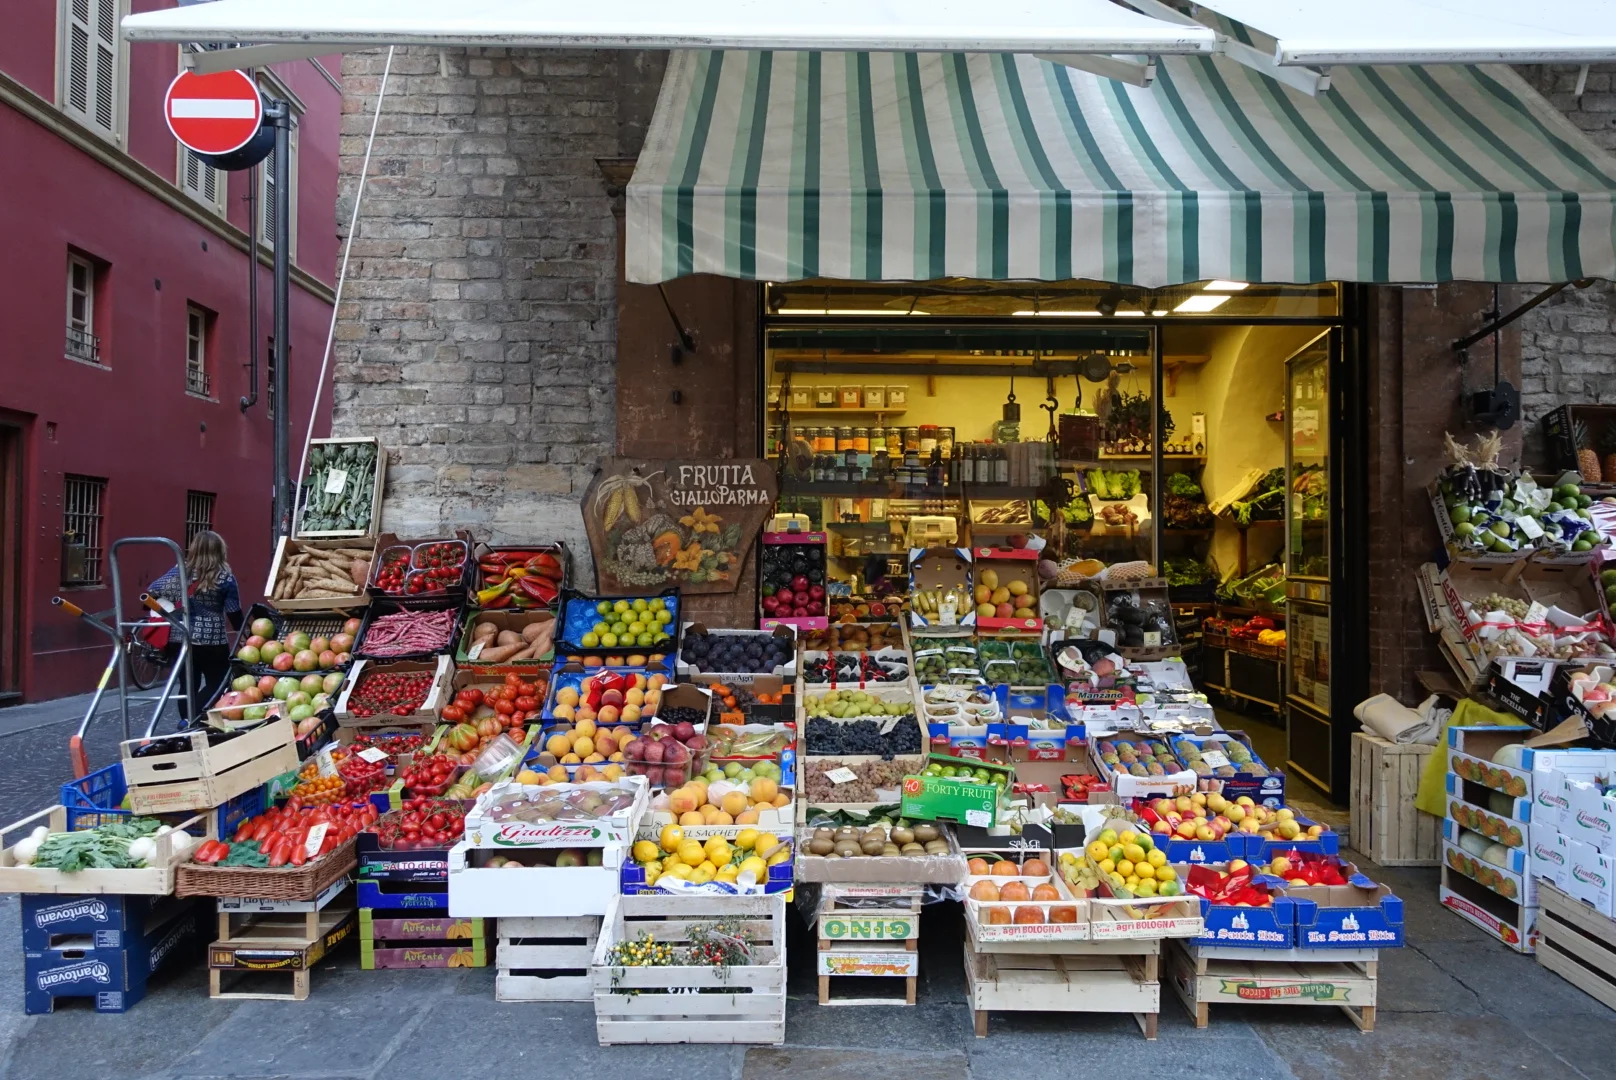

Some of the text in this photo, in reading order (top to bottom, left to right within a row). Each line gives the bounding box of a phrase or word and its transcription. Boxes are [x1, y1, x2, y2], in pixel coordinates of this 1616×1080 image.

[679, 465, 757, 489] FRUTTA
[670, 485, 770, 507] GIALLOPARMA
[1446, 588, 1474, 642] SELEXTA
[1500, 694, 1528, 717] EXCELLENT
[1509, 692, 1521, 704] THE
[904, 780, 919, 792] 40
[926, 783, 994, 800] FORTY FRUIT
[501, 824, 596, 840] Gradizzi
[382, 861, 416, 871] SALTO
[418, 861, 427, 870] di
[37, 901, 105, 926] Mantovani
[825, 920, 910, 939] GINO
[1002, 927, 1020, 936] agri
[1022, 926, 1062, 934] BOLOGNA
[1116, 920, 1176, 932] agri BOLOGNA
[1216, 928, 1255, 940] Santa
[1258, 929, 1284, 942] Rita
[1307, 929, 1395, 942] La Santa Rita
[39, 963, 107, 988] Mantovani
[1239, 988, 1266, 999] Circeo
